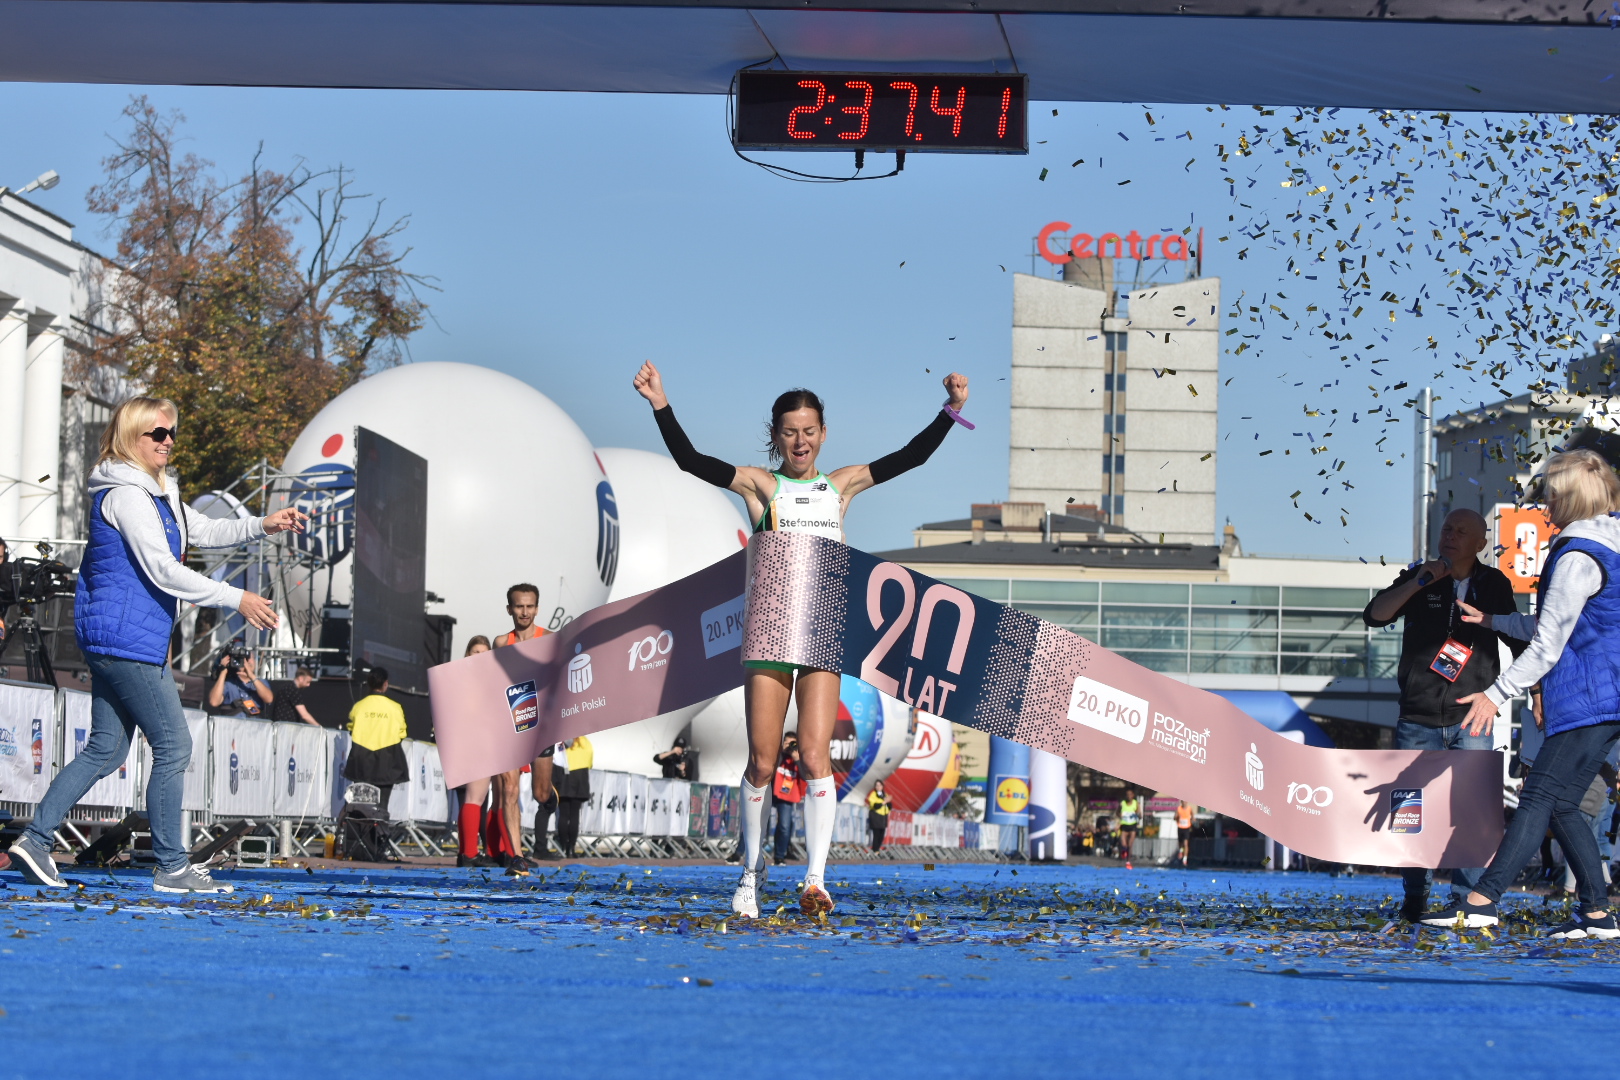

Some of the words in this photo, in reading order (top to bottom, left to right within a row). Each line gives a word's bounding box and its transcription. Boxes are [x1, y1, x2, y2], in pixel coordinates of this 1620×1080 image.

[706, 621, 725, 642] 20.
[628, 629, 674, 671] 100
[641, 659, 667, 670] 1919/2019
[509, 685, 529, 696] IAAF
[903, 667, 957, 717] LAT
[516, 711, 537, 722] BRONZE
[561, 704, 580, 718] Bank
[582, 696, 606, 711] Polski
[1077, 691, 1101, 715] 20.
[1105, 700, 1141, 728] PKO
[1239, 789, 1255, 806] Bank
[1286, 781, 1334, 808] 100
[1393, 791, 1416, 799] IAAF
